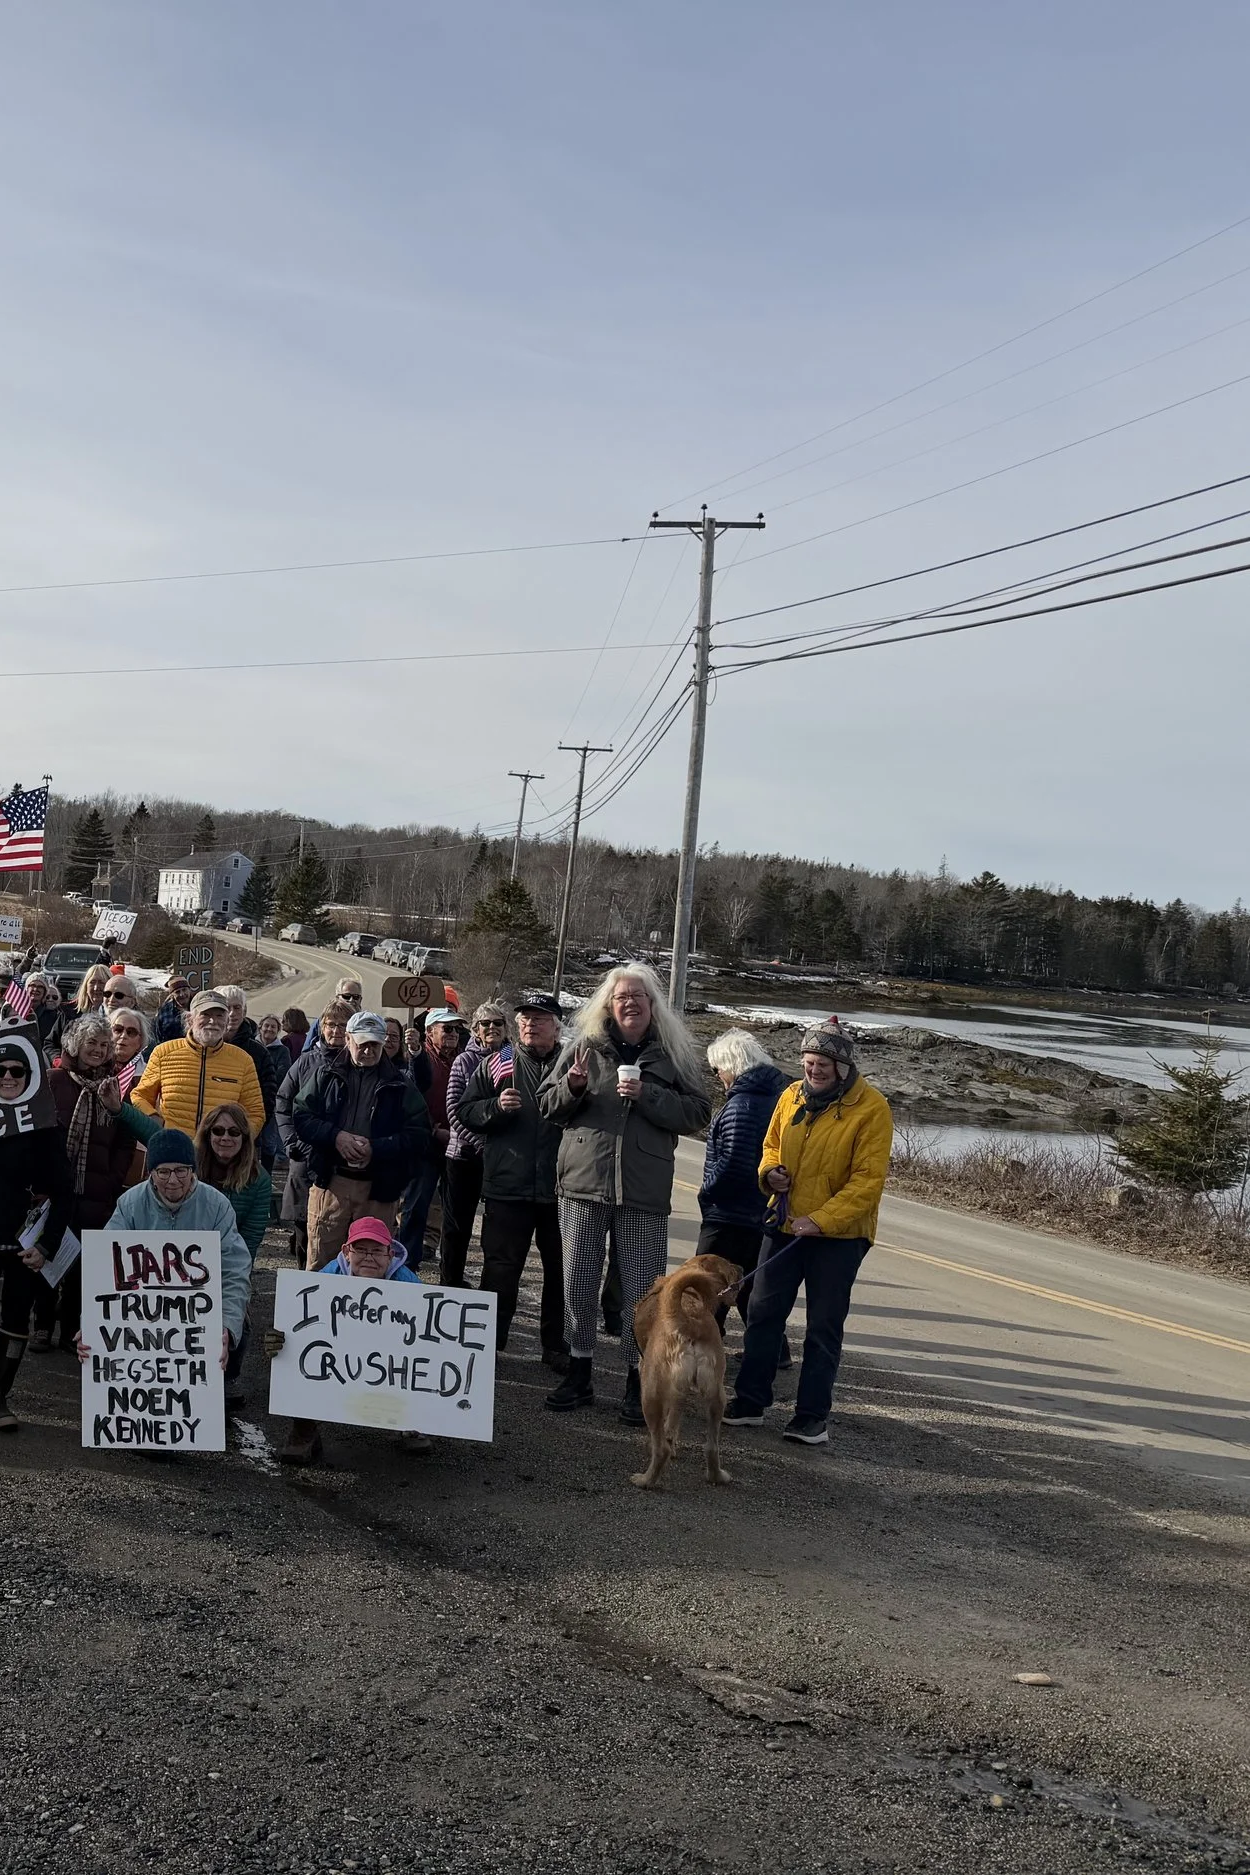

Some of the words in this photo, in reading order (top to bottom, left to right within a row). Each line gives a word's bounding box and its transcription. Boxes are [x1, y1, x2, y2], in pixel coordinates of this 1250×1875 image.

[103, 911, 120, 923] ICE
[96, 928, 127, 942] GOOD
[179, 946, 214, 966] END
[404, 985, 428, 998] ICE
[112, 1241, 211, 1291] LIARS
[95, 1292, 213, 1324] TRUMP
[292, 1284, 321, 1333] I
[330, 1286, 389, 1338] prefer
[390, 1309, 417, 1346] my
[418, 1291, 490, 1351] ICE
[99, 1325, 206, 1356] VANCE
[93, 1354, 207, 1387] HEGSETH
[299, 1340, 476, 1411] CRUSHED!
[108, 1386, 192, 1418] NOEM
[94, 1414, 201, 1446] KENNEDY
